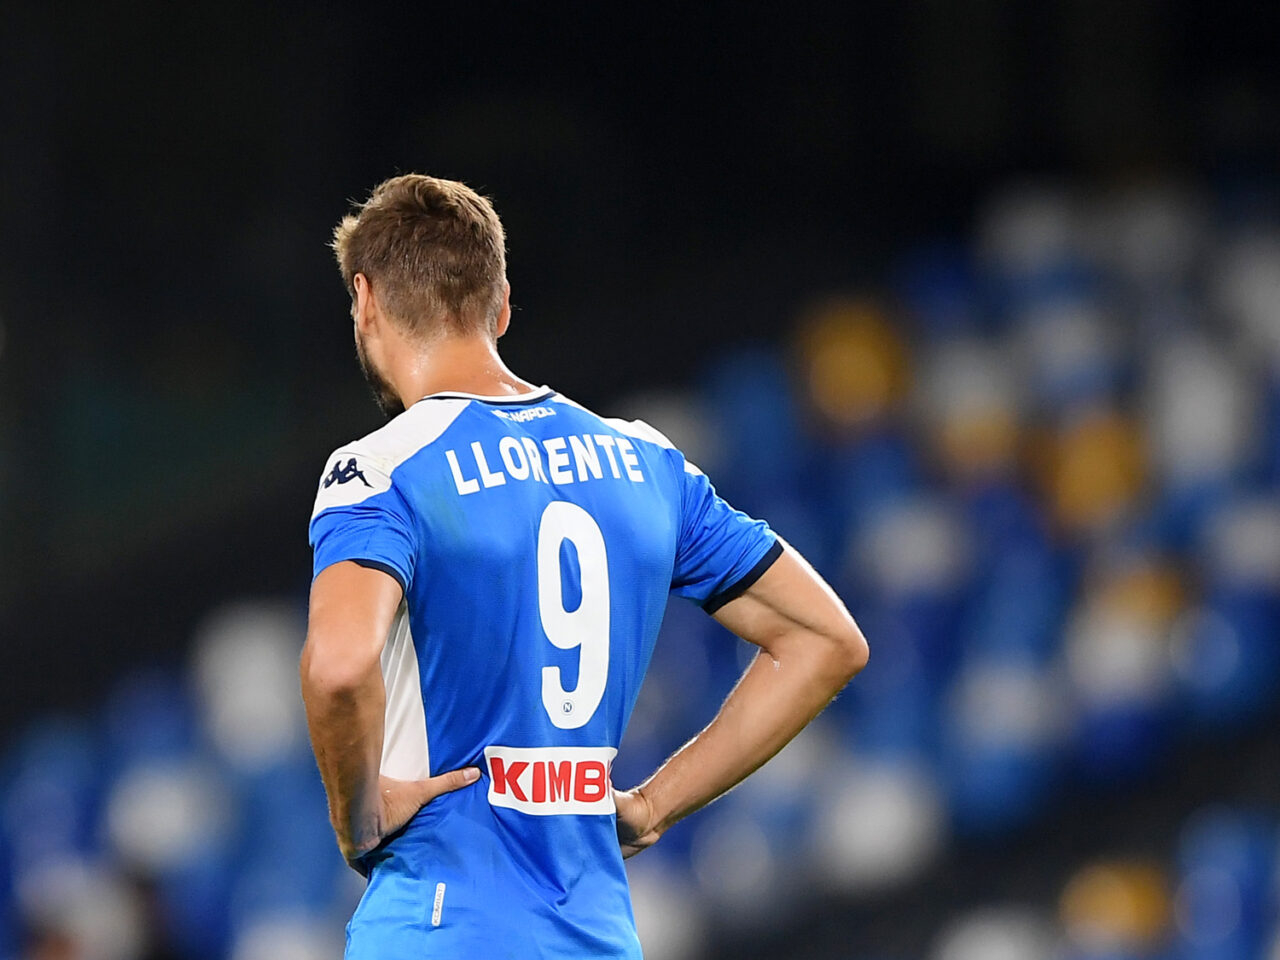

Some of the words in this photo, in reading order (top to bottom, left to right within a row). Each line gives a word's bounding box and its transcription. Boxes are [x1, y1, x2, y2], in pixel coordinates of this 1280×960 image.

[445, 434, 645, 496] LLORENTE
[537, 500, 610, 729] 9
[489, 757, 610, 803] KIMB
